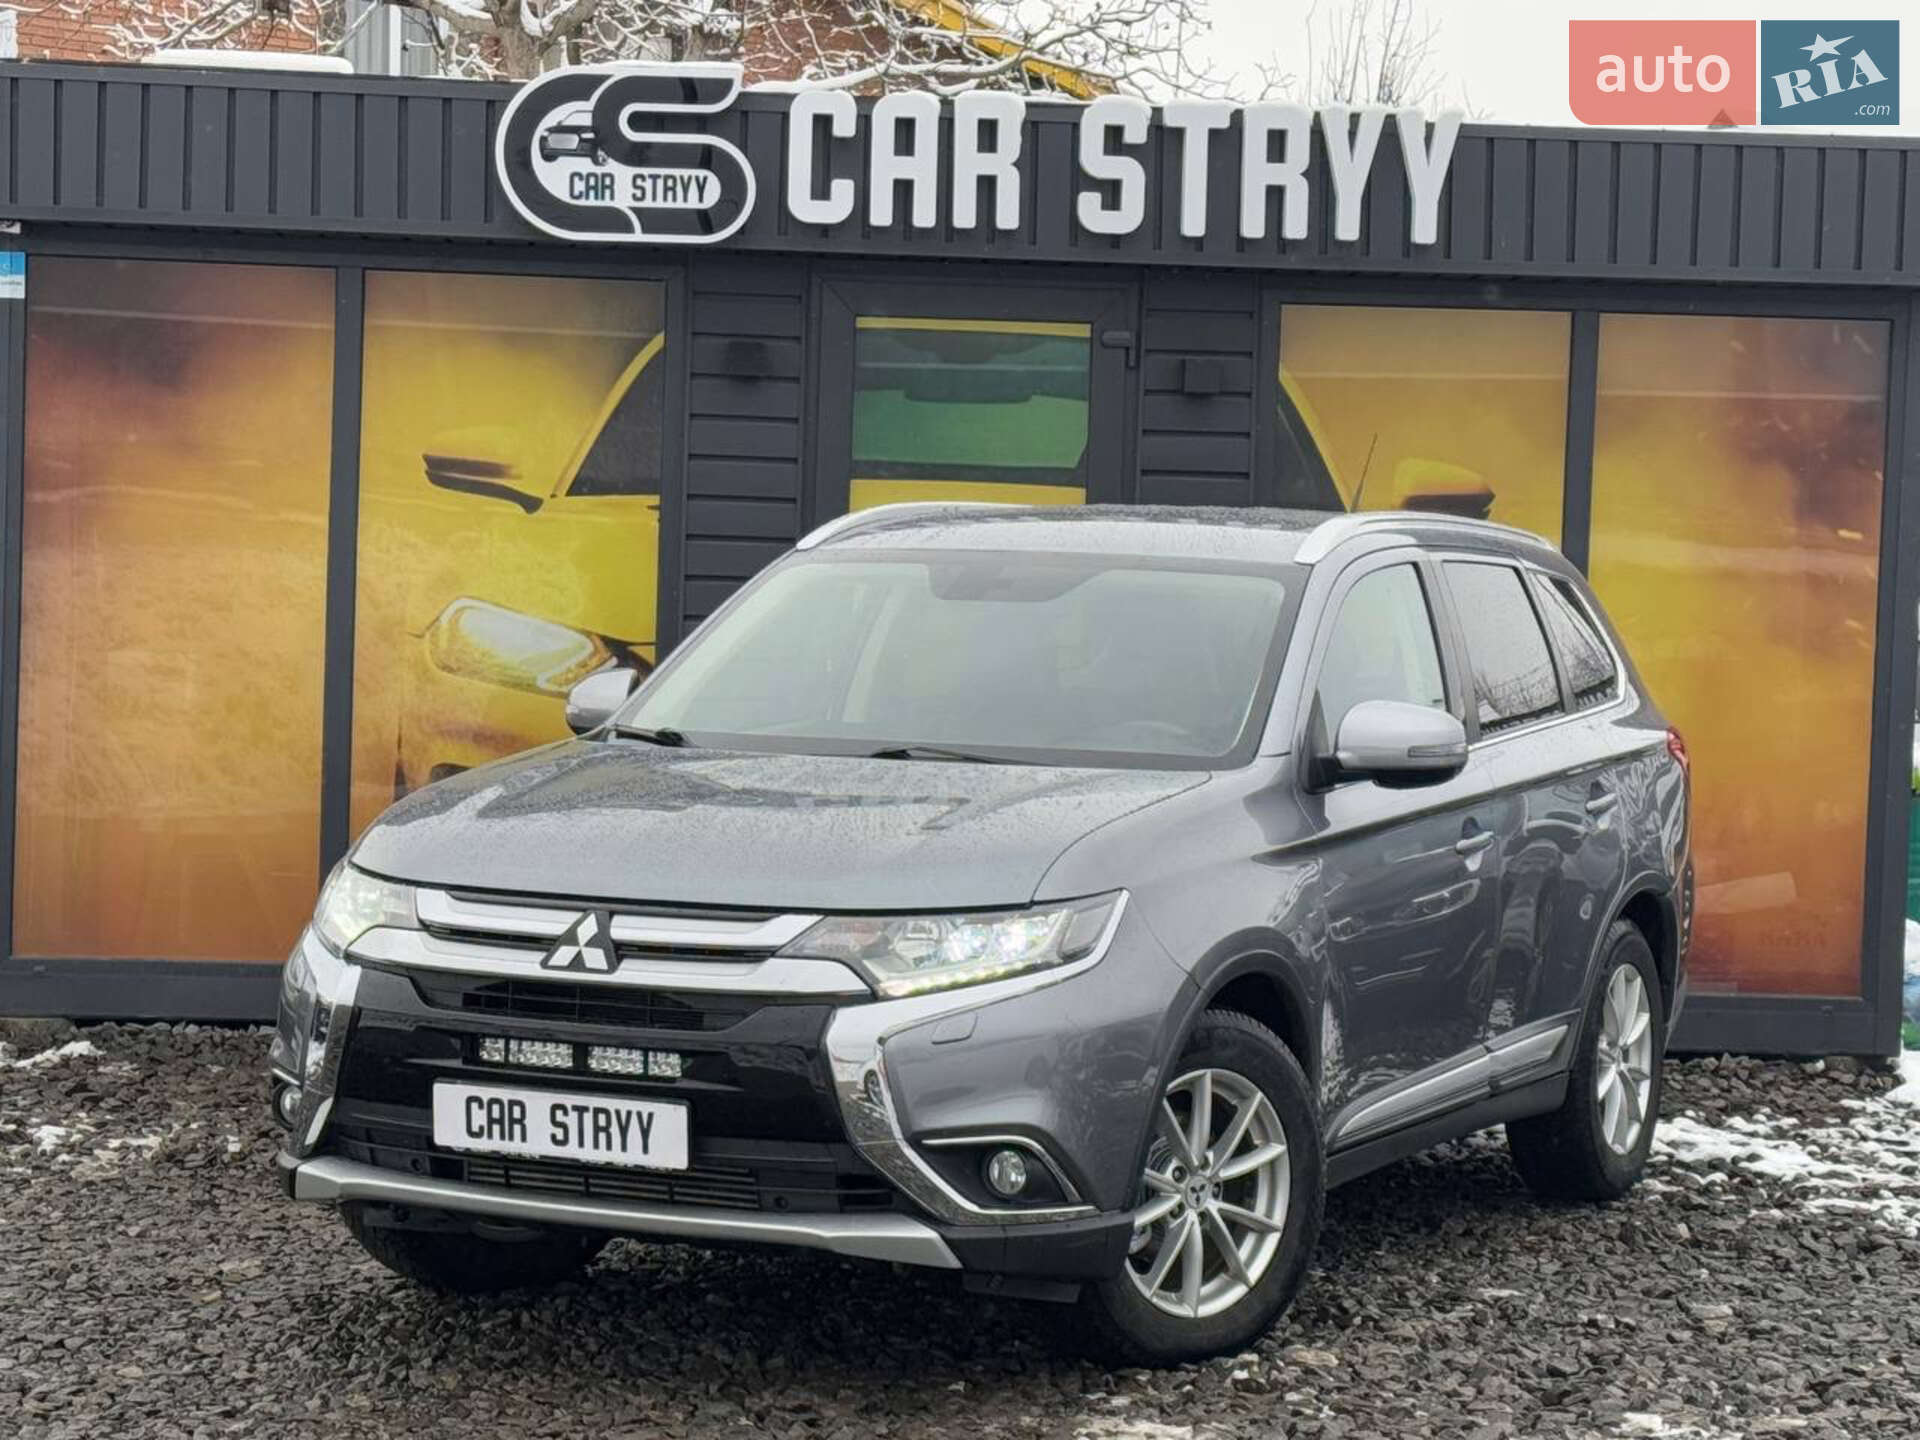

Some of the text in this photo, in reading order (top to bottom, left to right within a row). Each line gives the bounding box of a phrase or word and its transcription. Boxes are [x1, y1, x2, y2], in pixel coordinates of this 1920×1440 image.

[569, 172, 708, 203] CAR STRYY
[787, 89, 1465, 244] CAR STRYY
[465, 1095, 654, 1154] CAR STRYY
